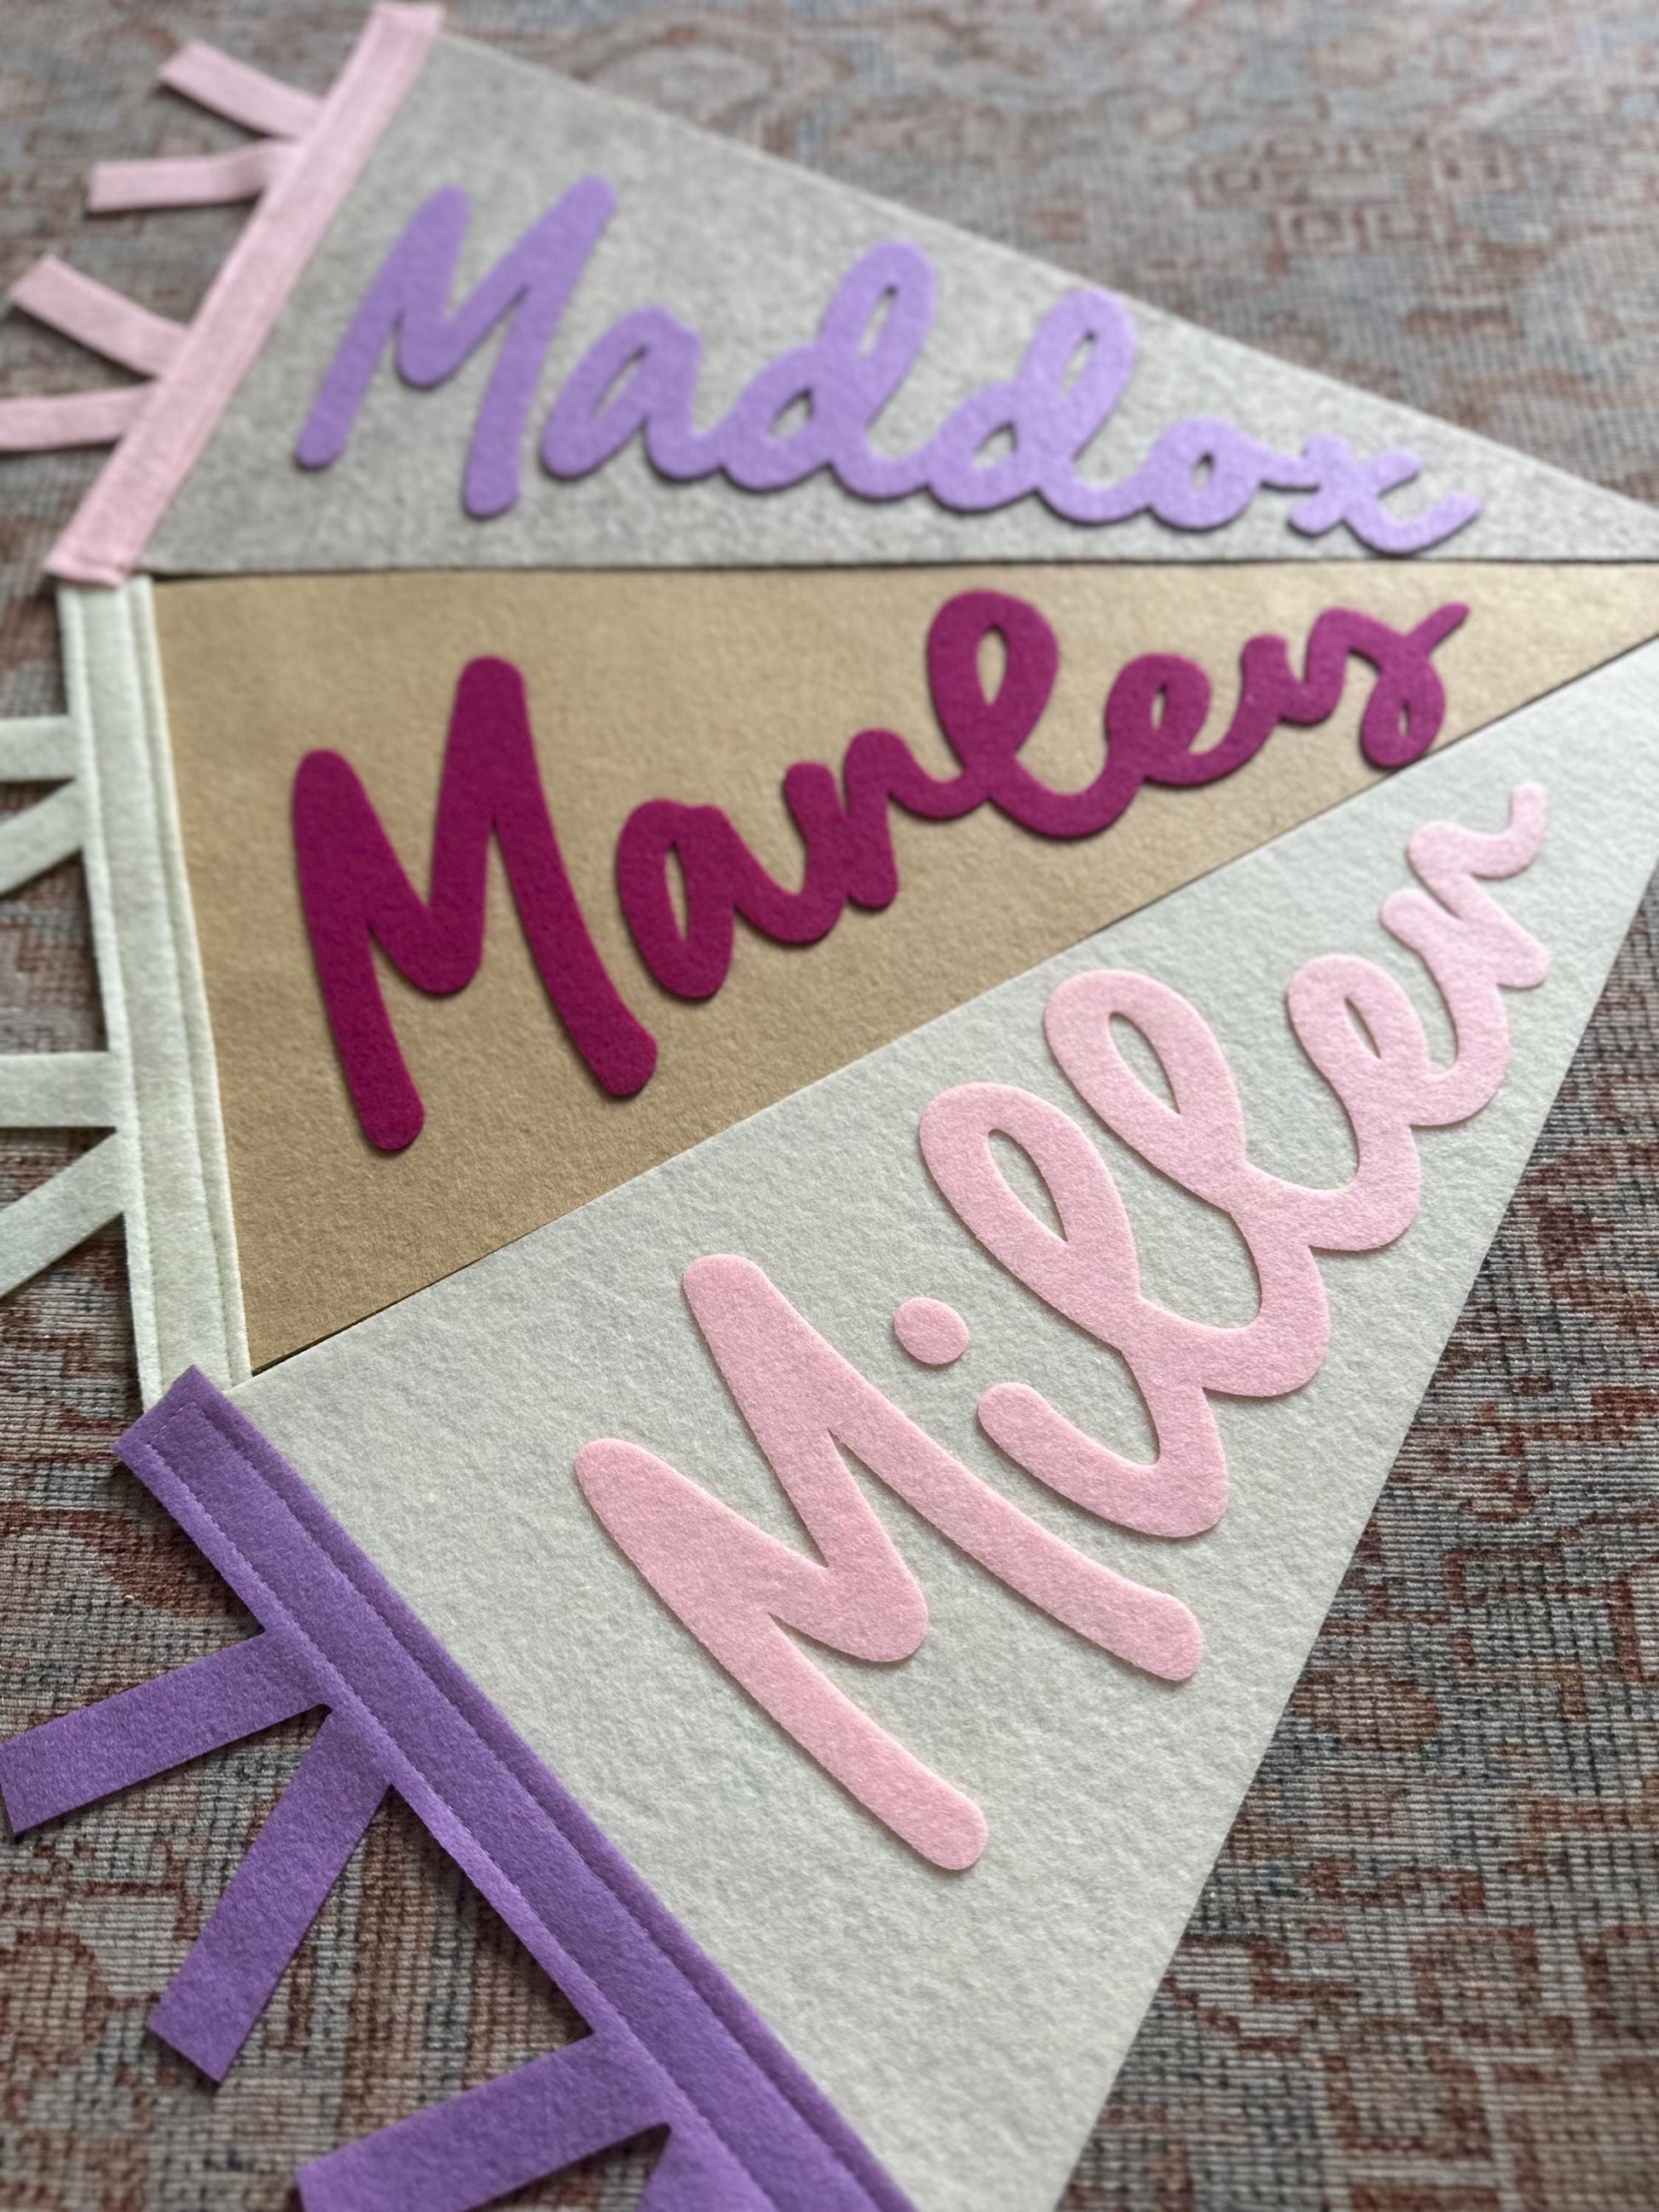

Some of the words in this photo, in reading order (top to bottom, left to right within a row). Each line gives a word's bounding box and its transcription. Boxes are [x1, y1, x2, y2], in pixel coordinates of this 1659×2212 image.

[296, 176, 1480, 554] Maddox
[292, 591, 1469, 1151] Marley
[575, 783, 1547, 1871] Miller
